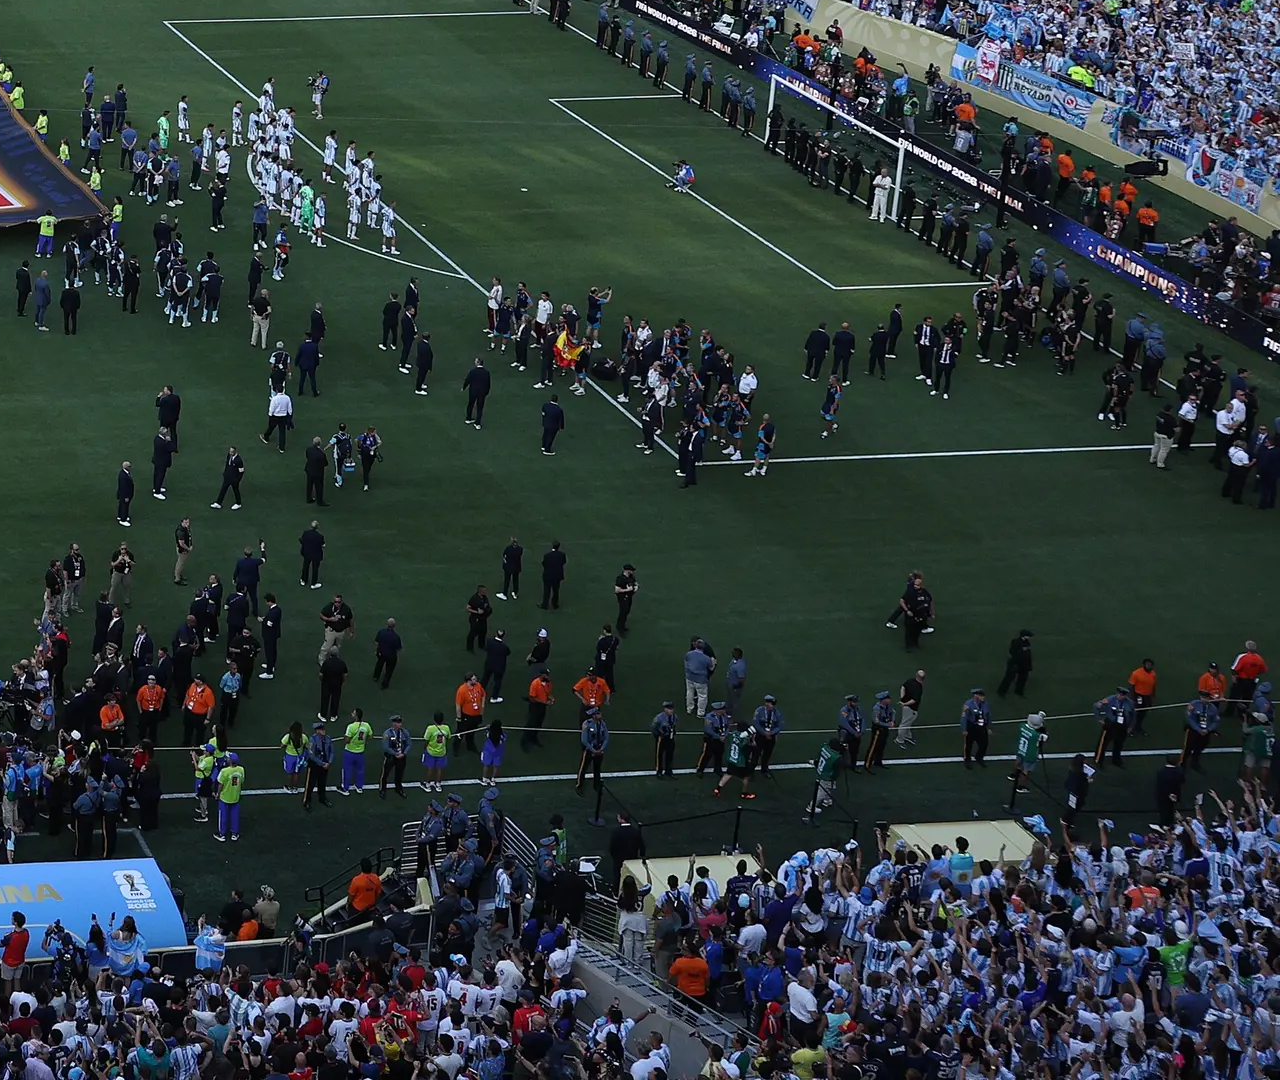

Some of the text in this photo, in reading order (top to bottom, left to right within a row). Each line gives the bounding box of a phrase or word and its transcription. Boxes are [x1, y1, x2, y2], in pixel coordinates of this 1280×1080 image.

[635, 0, 648, 13] FIFA
[647, 6, 667, 22] WORLD
[912, 145, 937, 164] WORLD
[937, 159, 952, 172] CUP
[951, 166, 978, 186] 2026
[978, 181, 996, 197] THE
[1097, 244, 1177, 297] CHAMPIONS
